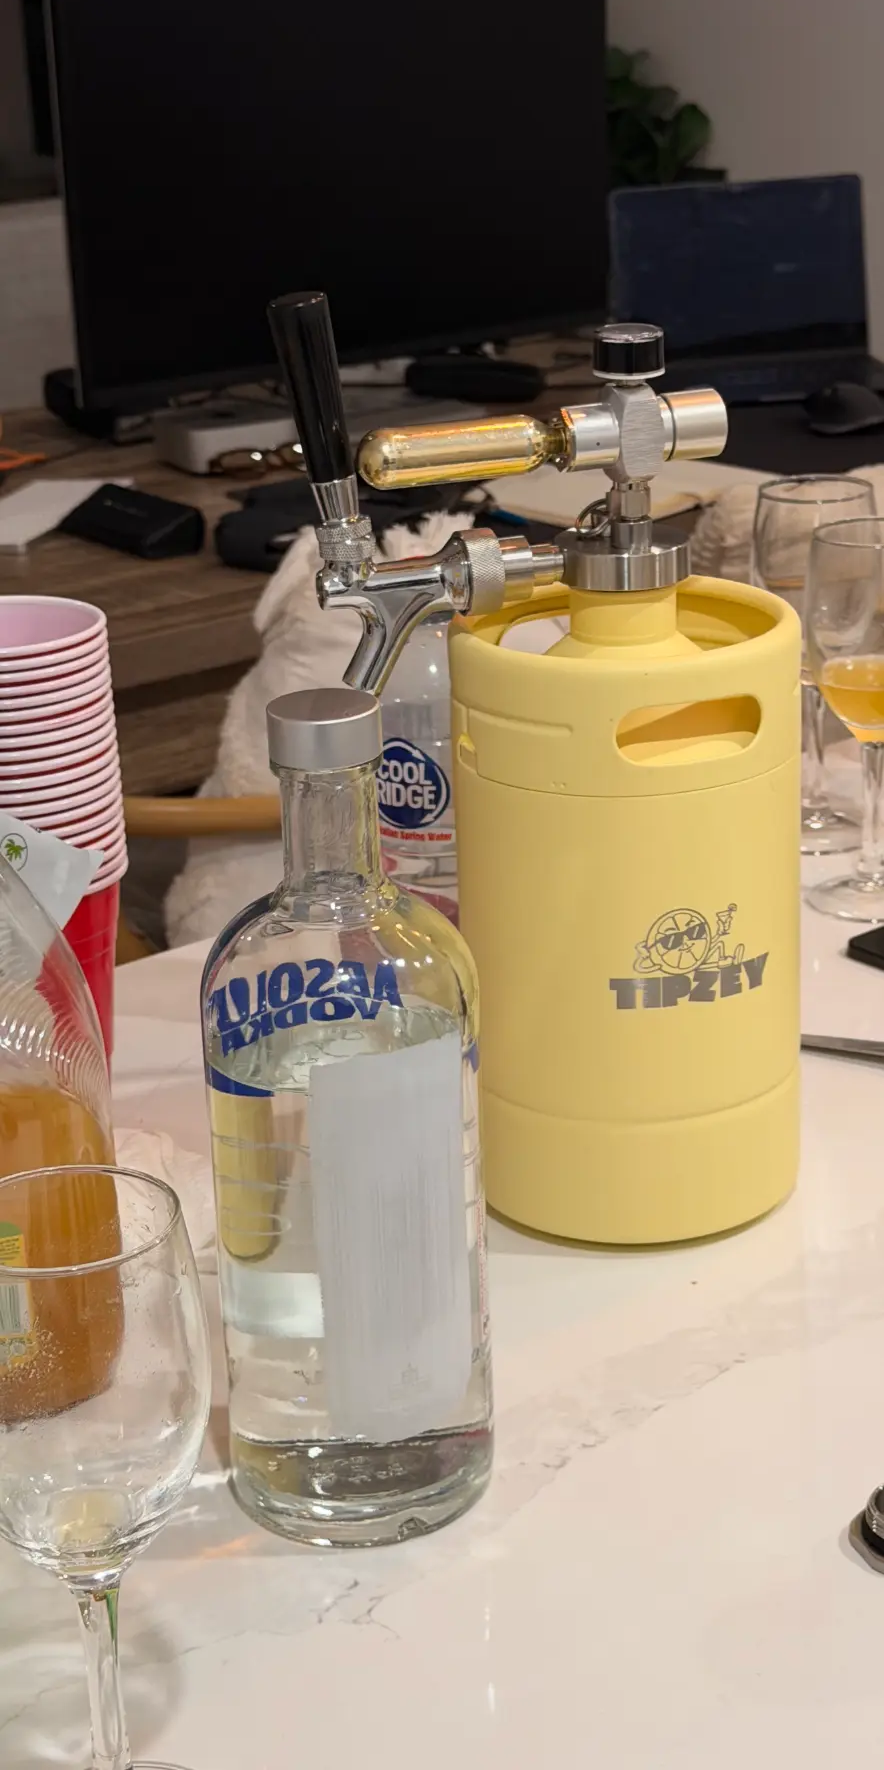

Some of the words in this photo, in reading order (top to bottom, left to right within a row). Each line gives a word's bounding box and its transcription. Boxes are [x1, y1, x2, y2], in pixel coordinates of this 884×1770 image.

[378, 759, 432, 785] COOL
[376, 778, 436, 809] RIDGE
[427, 833, 452, 842] Water
[609, 951, 769, 1010] TIPZEY
